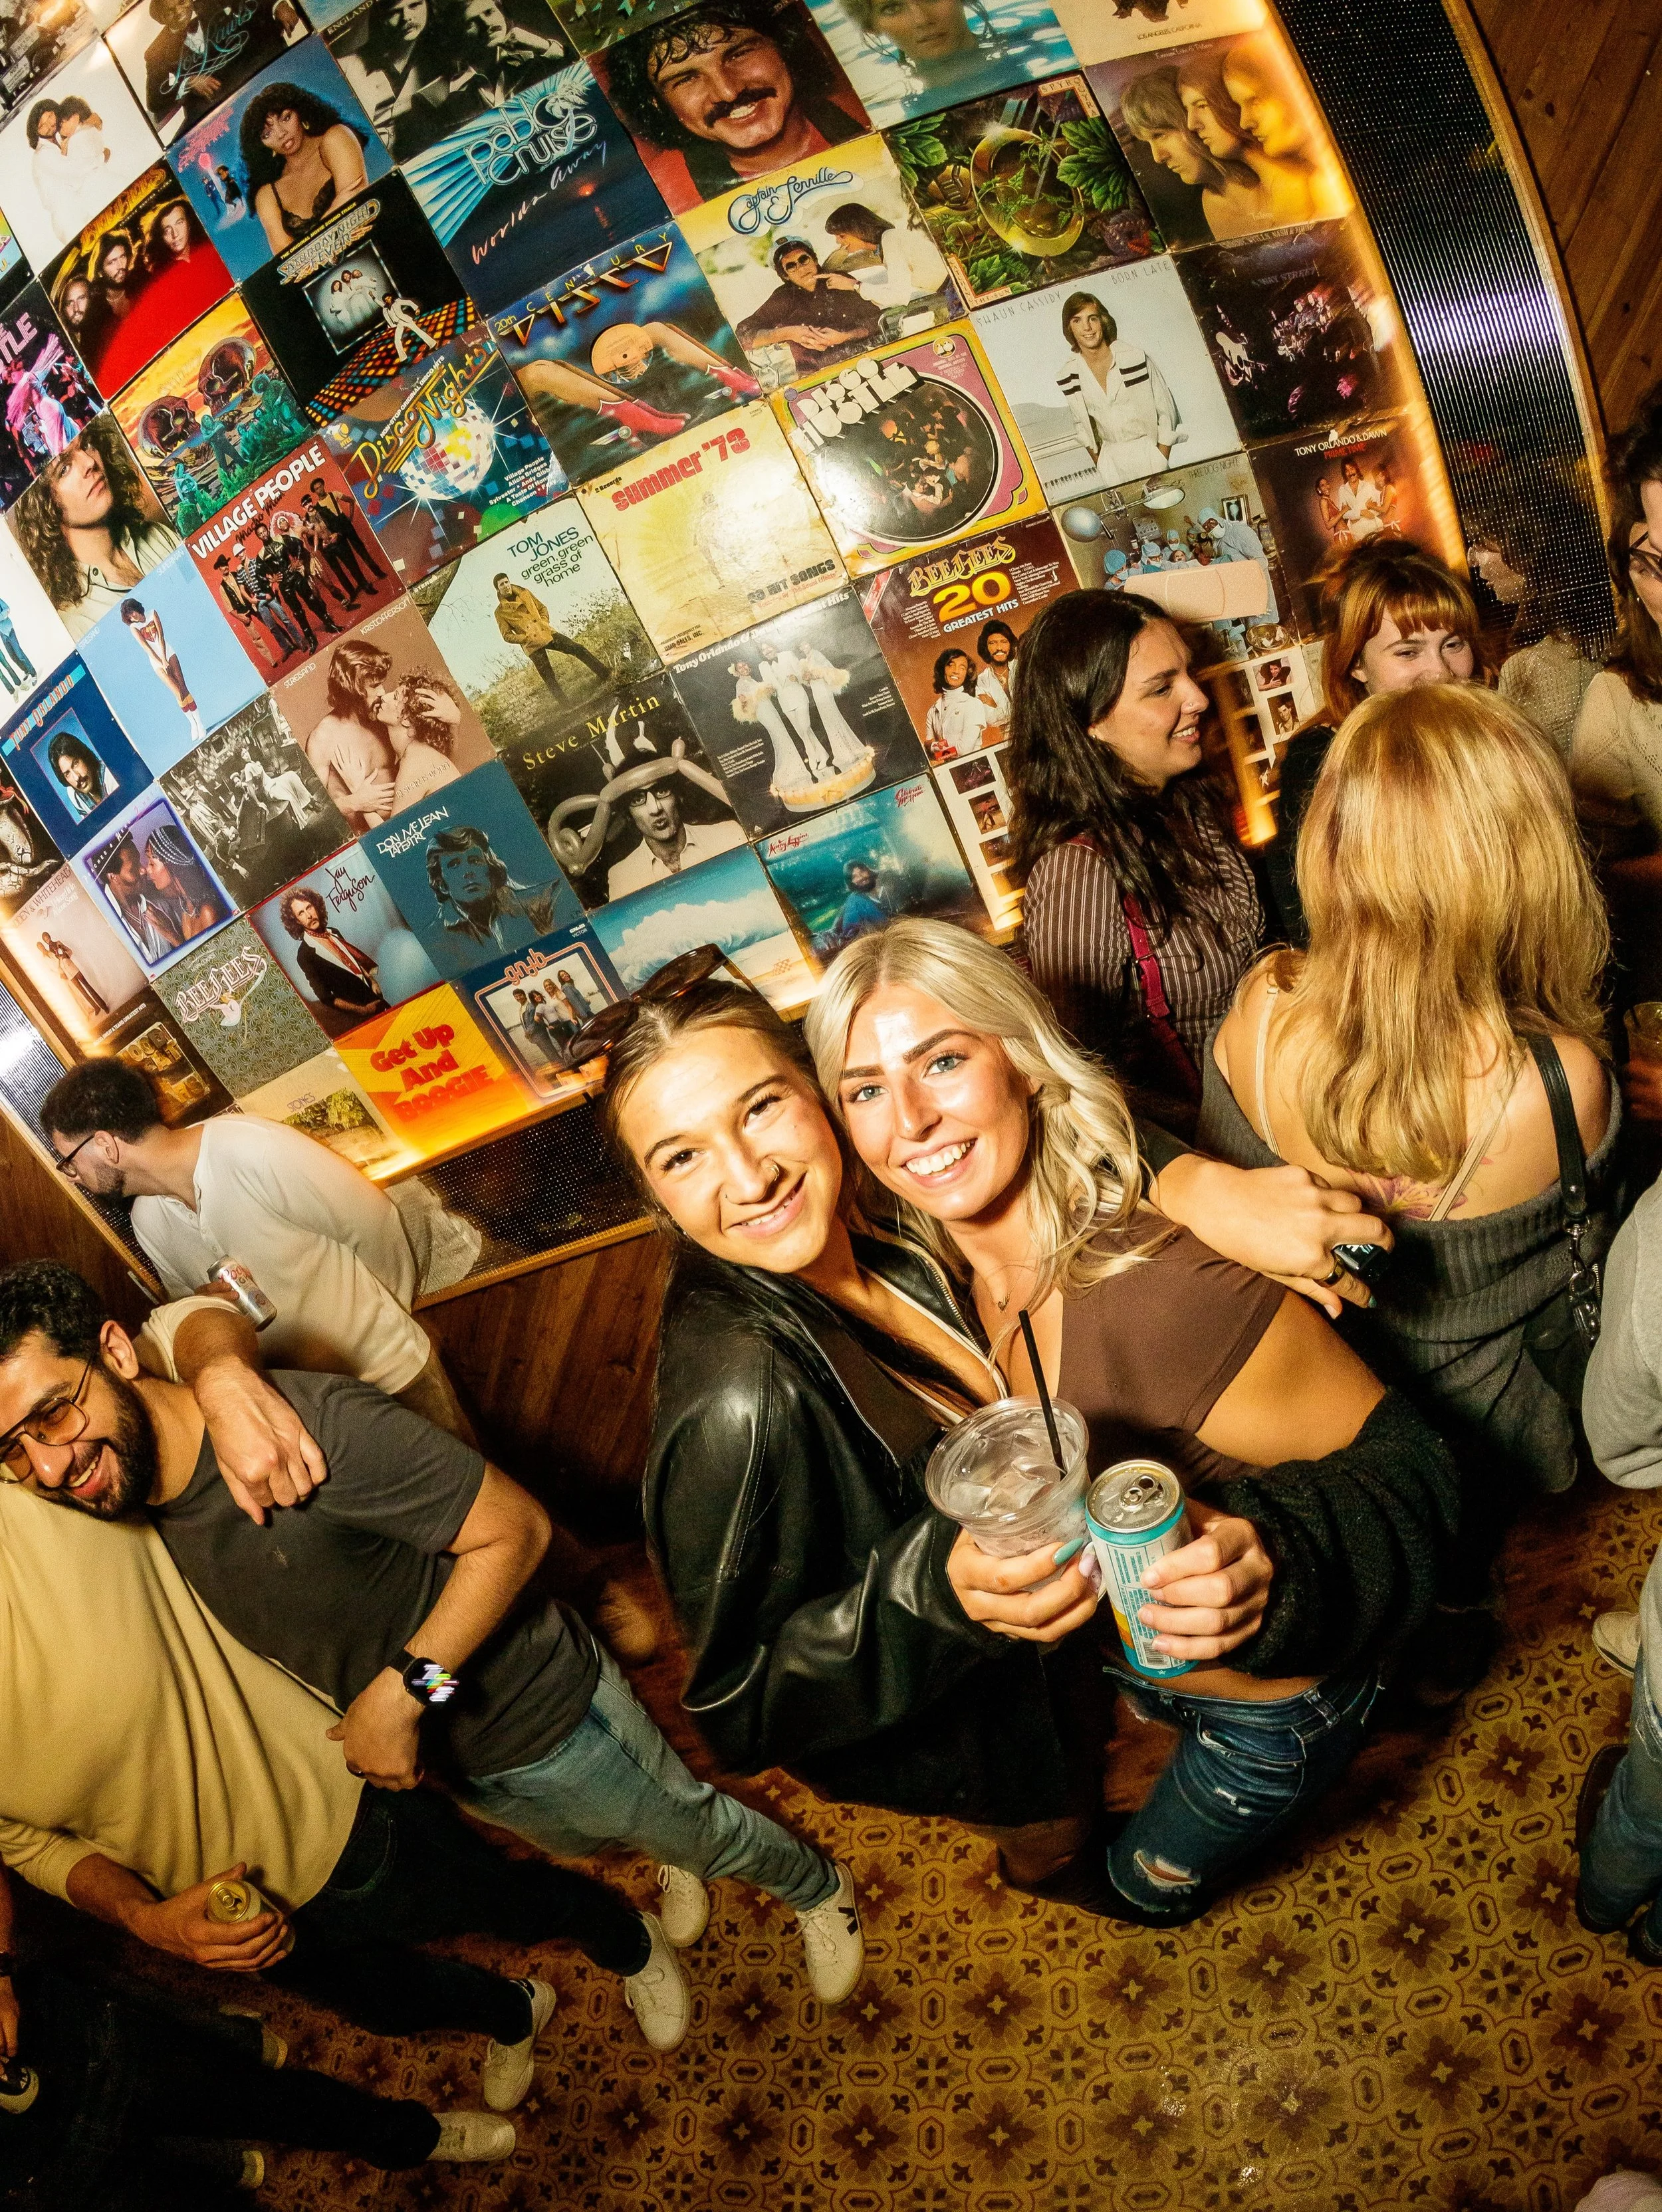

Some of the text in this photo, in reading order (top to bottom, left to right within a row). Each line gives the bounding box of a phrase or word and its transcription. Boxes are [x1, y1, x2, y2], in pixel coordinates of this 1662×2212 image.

[327, 1, 373, 35] ENGLAND
[1041, 78, 1081, 92] SPYRO
[463, 95, 571, 186] pablo
[487, 114, 598, 185] cruise
[779, 167, 854, 217] Tennille
[281, 202, 357, 260] THE ORIGINAL MOVIE SOUND TRACK
[336, 203, 371, 236] NIGHT
[310, 233, 352, 269] FEVER
[1111, 260, 1170, 285] BORN LATE
[494, 314, 517, 332] 20th
[976, 291, 1062, 327] SHAUN CASSIDY
[378, 356, 443, 438] NON-STOP ORIGINAL DISCO HITS
[788, 362, 919, 457] HUSTLE
[342, 347, 487, 499] Disco Nights
[701, 427, 751, 462] '73
[1294, 444, 1316, 457] TONY
[1318, 435, 1356, 451] ORLANDO
[1362, 429, 1387, 442] DAWN
[1324, 442, 1367, 460] PRIME TIME
[489, 467, 550, 505] Sylvester Andy Gibb
[504, 457, 544, 481] Village People
[509, 462, 547, 487] Alicia Bridges
[191, 444, 326, 560] VILLAGE PEOPLE
[511, 488, 527, 499] Taste
[512, 490, 537, 506] Chanson
[507, 531, 543, 558] TOM
[521, 534, 594, 580] green, green
[531, 526, 579, 562] JONES
[534, 549, 582, 584] grass of
[543, 564, 580, 587] home
[766, 578, 789, 596] HIT
[790, 558, 836, 586] SONGS
[933, 570, 1011, 623] 20
[360, 598, 412, 635] KRISTOFFERSON
[943, 598, 1020, 633] GREATEST HITS
[673, 657, 699, 675] Tony
[697, 637, 741, 663] Orlando
[827, 592, 850, 608] Hits
[692, 630, 704, 639] INC.
[283, 663, 316, 689] STREISAND
[9, 674, 74, 751] TONY ORLANDO
[523, 696, 660, 770] Steve Martin
[404, 777, 422, 794] STAR
[376, 832, 401, 855] DON
[389, 824, 431, 858] TAPESTRY
[32, 866, 72, 907] WHITEHEAD
[325, 866, 352, 895] Jay
[326, 875, 376, 913] Ferguson
[572, 927, 588, 939] VICTOR
[370, 1024, 455, 1073] Get Up
[400, 1048, 459, 1093] And
[287, 1091, 316, 1113] STONES
[393, 1064, 495, 1122] BOOGIE
